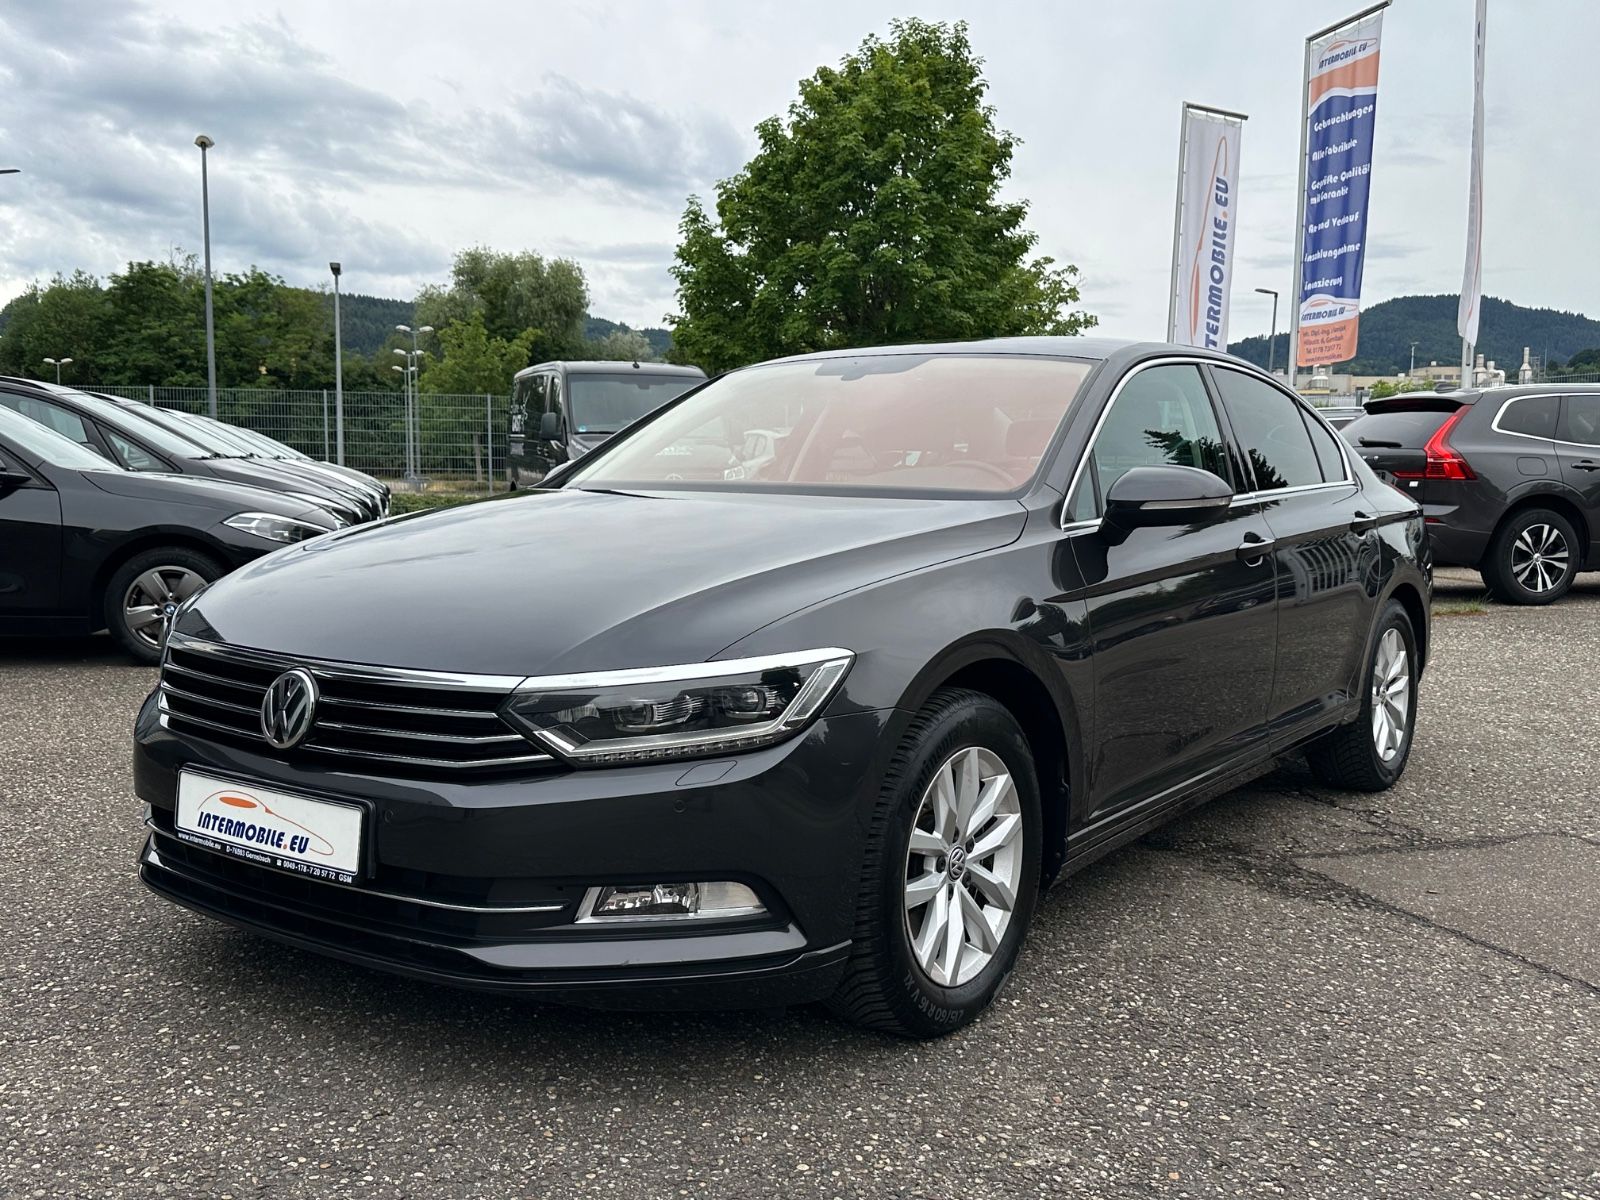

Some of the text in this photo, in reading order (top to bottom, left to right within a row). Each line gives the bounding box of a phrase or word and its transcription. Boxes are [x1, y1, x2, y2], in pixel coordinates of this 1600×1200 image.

[1204, 175, 1229, 348] TERMOBILE.EU
[197, 811, 310, 854] INTERMOBILE.EU
[338, 873, 352, 883] GSM
